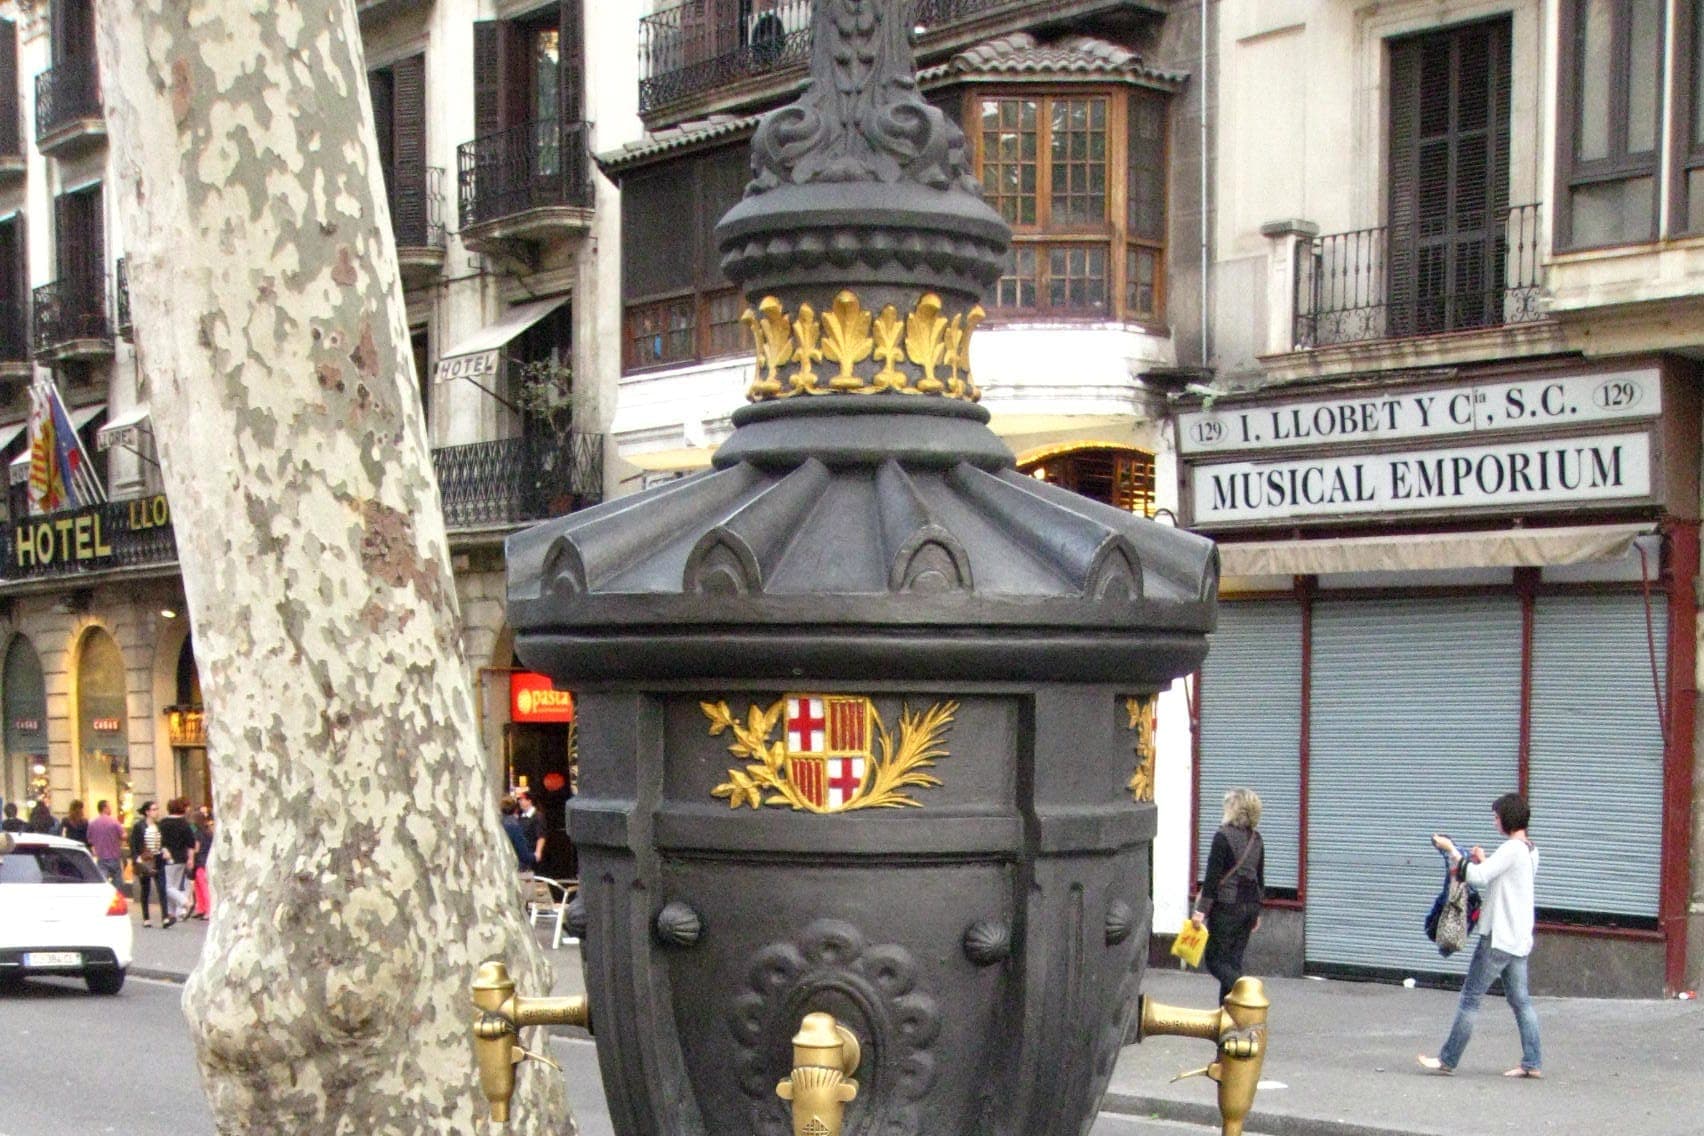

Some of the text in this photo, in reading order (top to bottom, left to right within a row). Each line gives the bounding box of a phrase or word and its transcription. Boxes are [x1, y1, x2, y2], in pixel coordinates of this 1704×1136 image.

[440, 353, 494, 378] HOTEL
[1197, 421, 1222, 442] 129
[1240, 413, 1261, 442] I.
[1271, 400, 1402, 440] LLOBET
[1414, 397, 1435, 427] Y
[1505, 383, 1577, 419] S.C.
[1601, 382, 1635, 407] 129
[1211, 445, 1624, 511] MUSICAL EMPORIUM
[16, 494, 169, 566] HOTEL LLO
[532, 690, 570, 713] pasta
